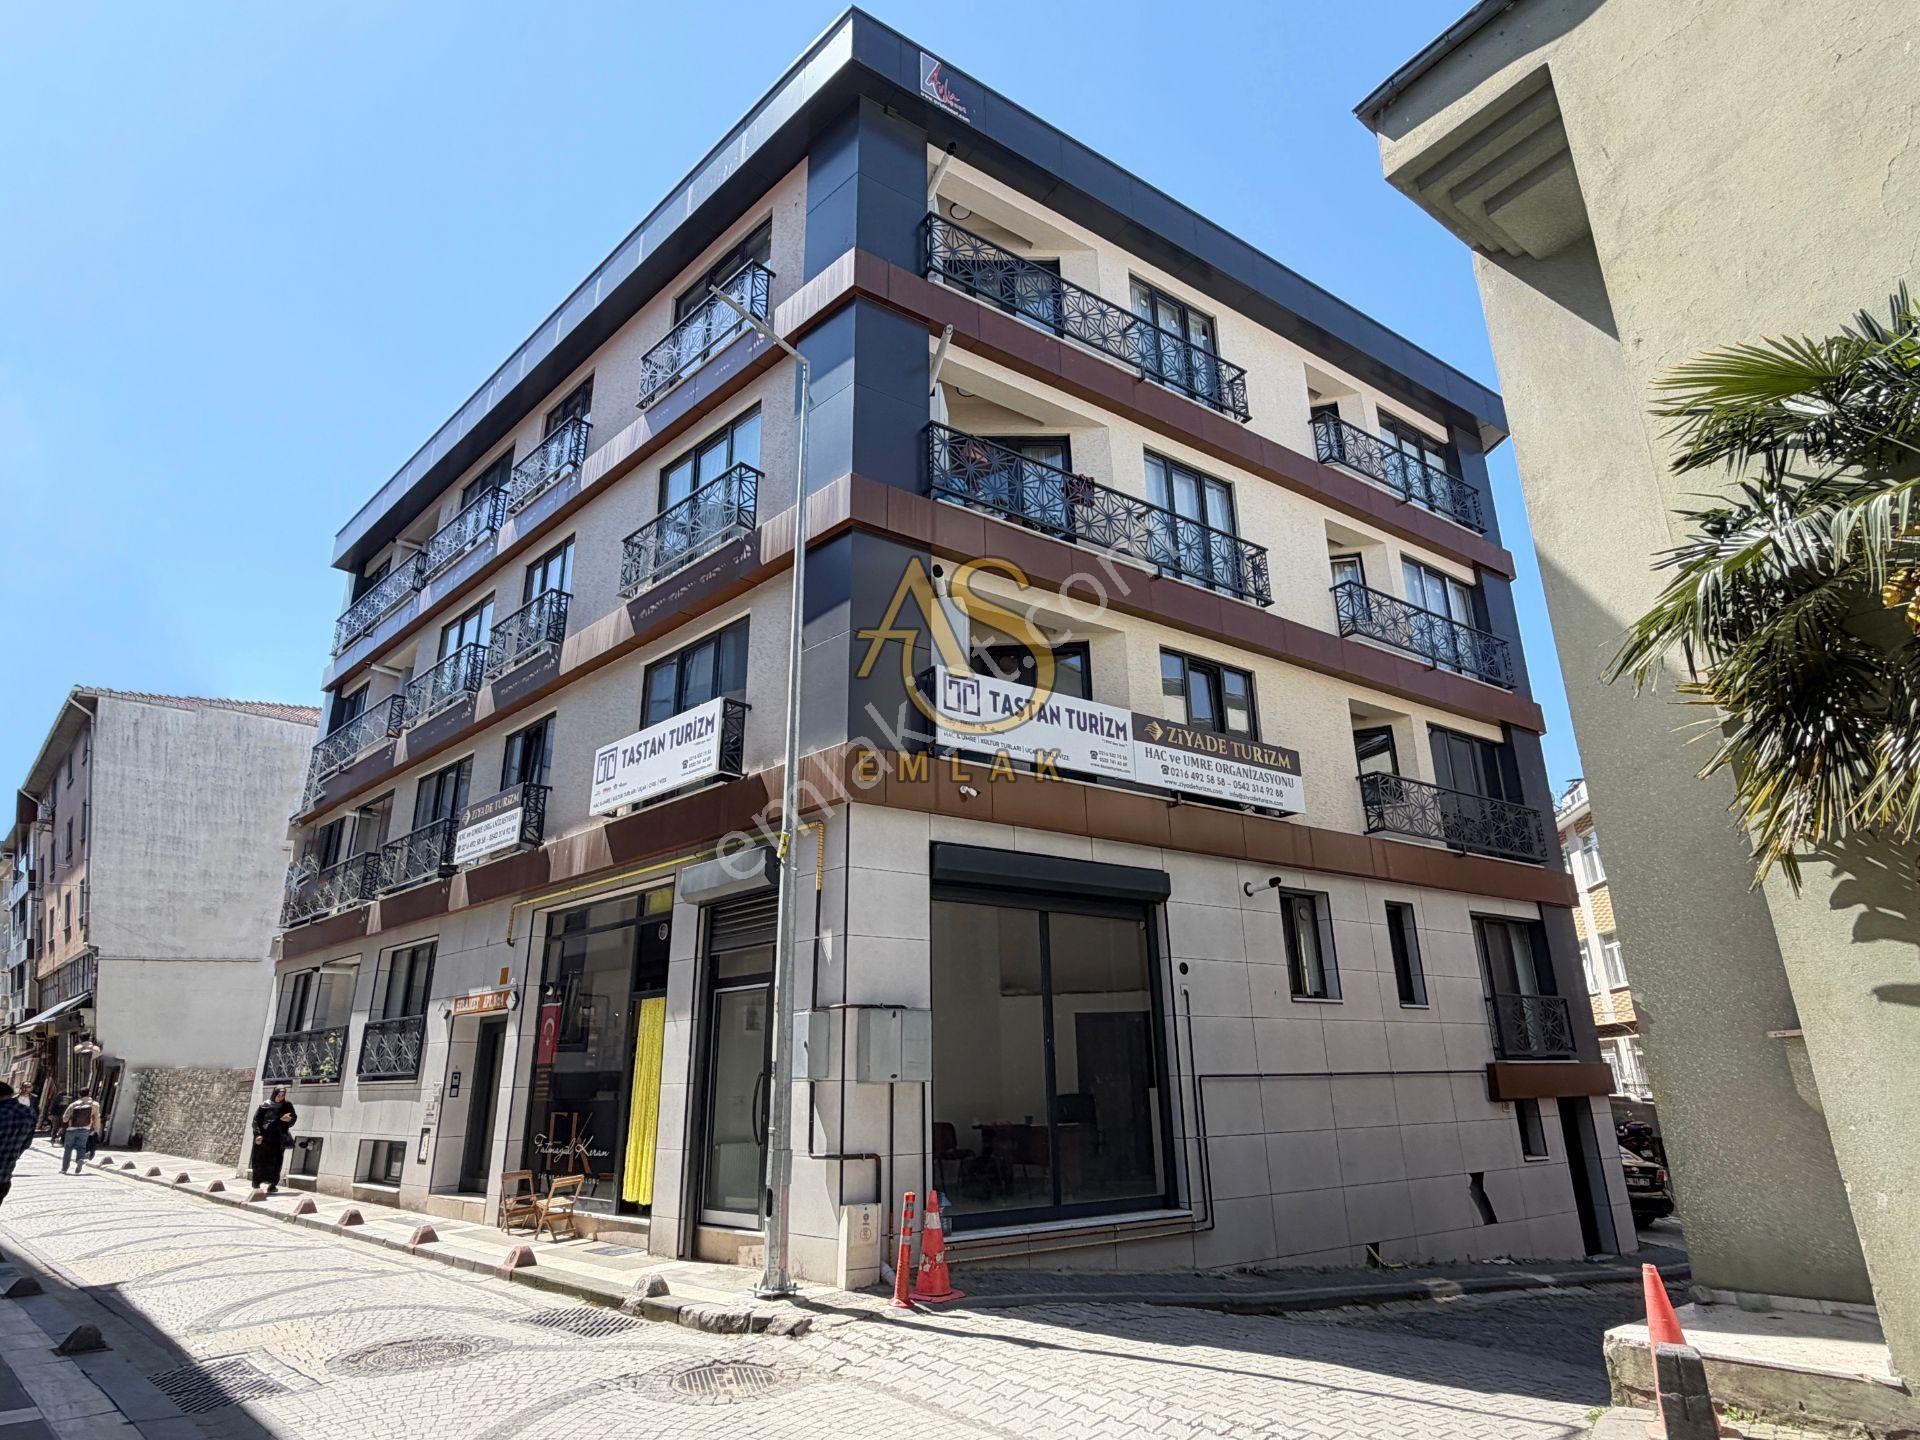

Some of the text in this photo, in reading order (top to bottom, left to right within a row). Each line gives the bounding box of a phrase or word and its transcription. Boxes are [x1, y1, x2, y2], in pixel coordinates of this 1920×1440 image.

[989, 690, 1060, 726] TAŞTAN
[1065, 708, 1128, 741] TURİZM
[622, 732, 666, 769] TAŞTAN
[669, 712, 715, 749] TURİZM
[1145, 746, 1294, 788] HAC ve UMRE ORGANİZASYONU
[1170, 767, 1188, 779] 0216
[1191, 771, 1204, 782] 492
[1206, 774, 1215, 785] 58
[1217, 775, 1225, 786] 58
[1233, 780, 1250, 791] 0542
[1252, 784, 1264, 795] 314
[1266, 786, 1274, 797] 92
[1275, 787, 1284, 798] 88
